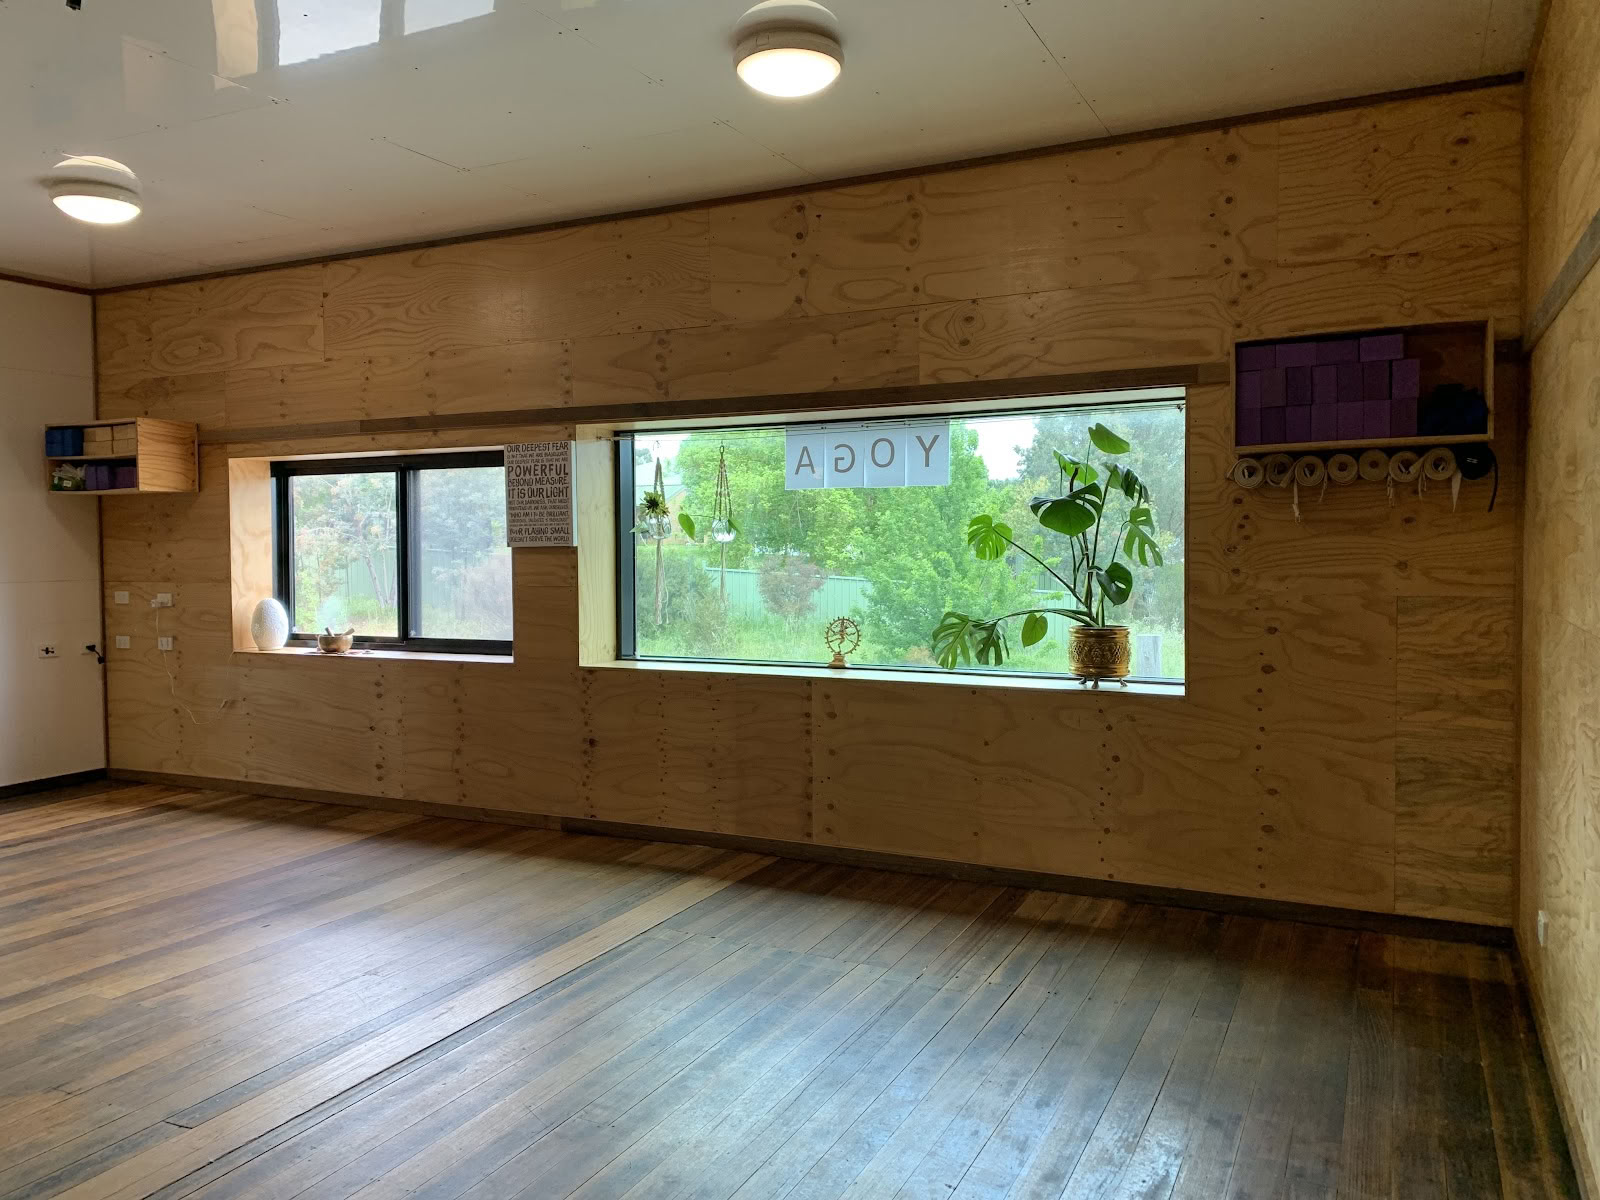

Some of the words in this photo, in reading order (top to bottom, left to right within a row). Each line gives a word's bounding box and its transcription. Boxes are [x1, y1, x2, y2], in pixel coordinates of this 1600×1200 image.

[506, 444, 520, 453] OUR
[522, 443, 550, 452] DEEPEST
[552, 442, 568, 451] FEAR
[508, 464, 568, 477] POWERFUL
[508, 478, 533, 487] BEYOND
[508, 488, 515, 499] IT
[528, 487, 544, 499] OUR
[524, 527, 549, 535] PLAYING
[550, 527, 569, 535] SMALL
